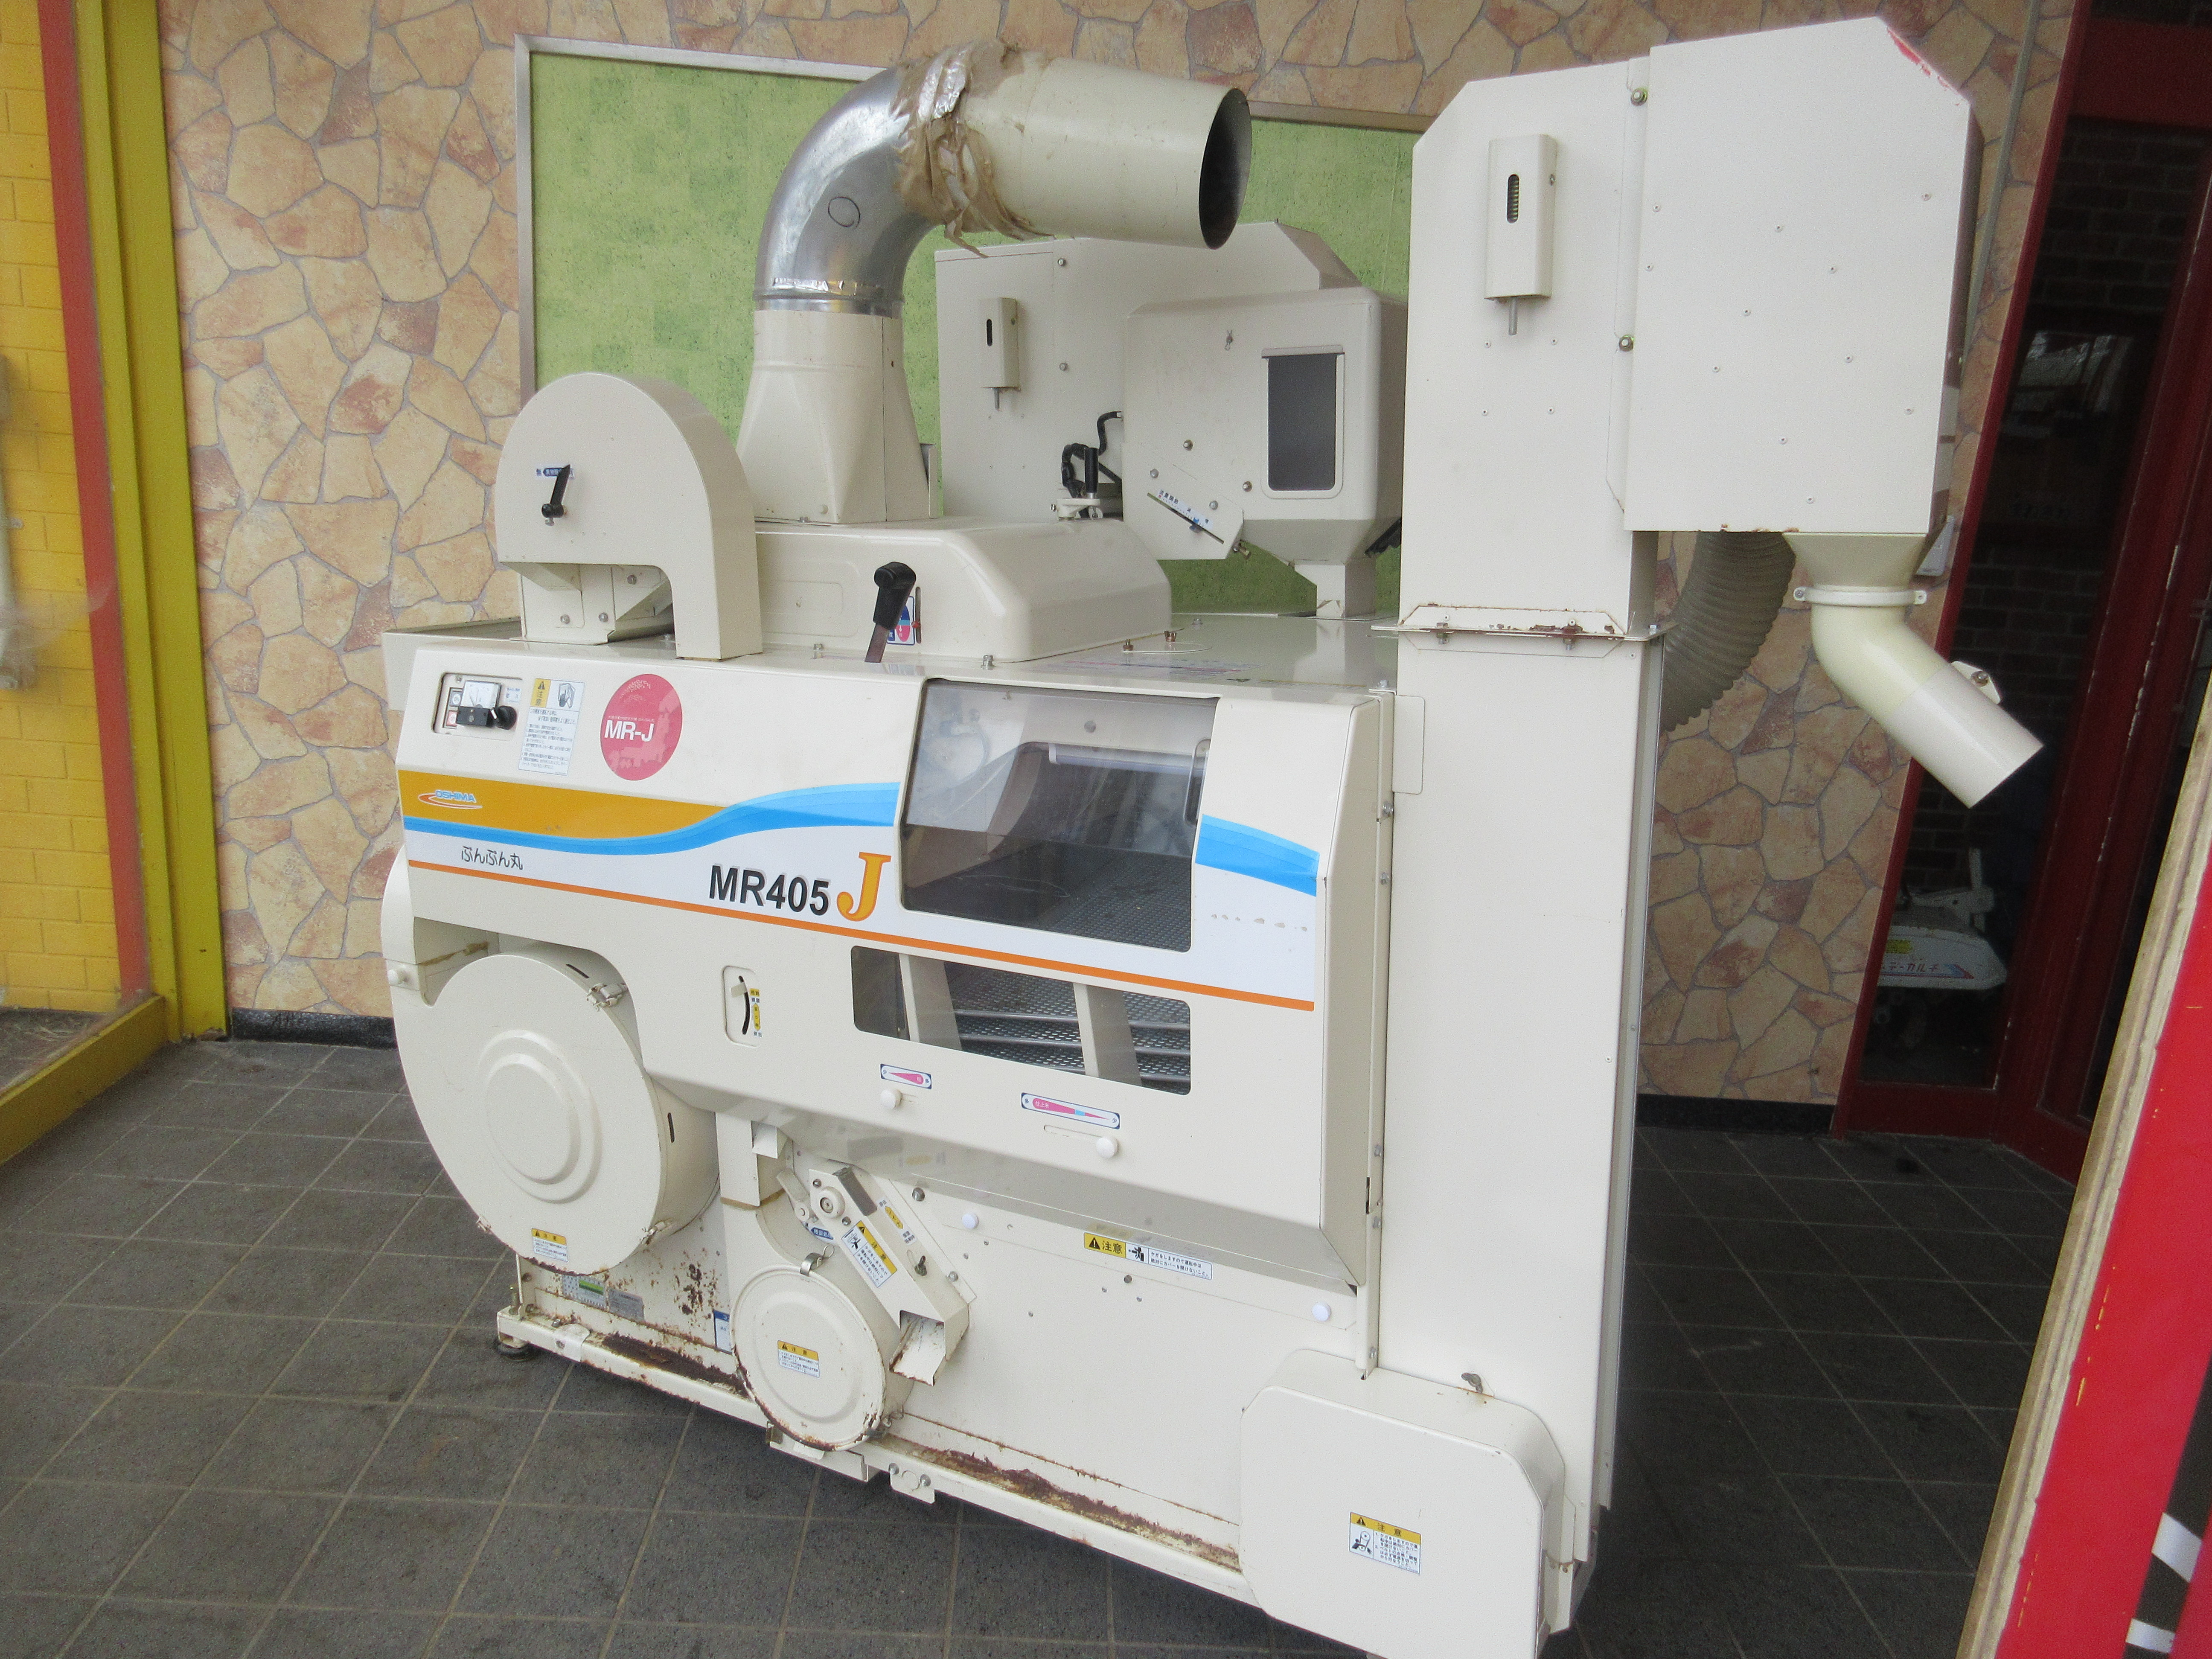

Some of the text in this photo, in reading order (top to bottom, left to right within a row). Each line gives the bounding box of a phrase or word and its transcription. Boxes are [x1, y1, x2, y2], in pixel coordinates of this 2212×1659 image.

[604, 720, 655, 742] MR-J
[435, 789, 477, 803] OSHIMA
[461, 846, 523, 870] ぶんぶん丸
[1101, 1240, 1123, 1254] 注意
[1377, 1522, 1402, 1537] 注意
